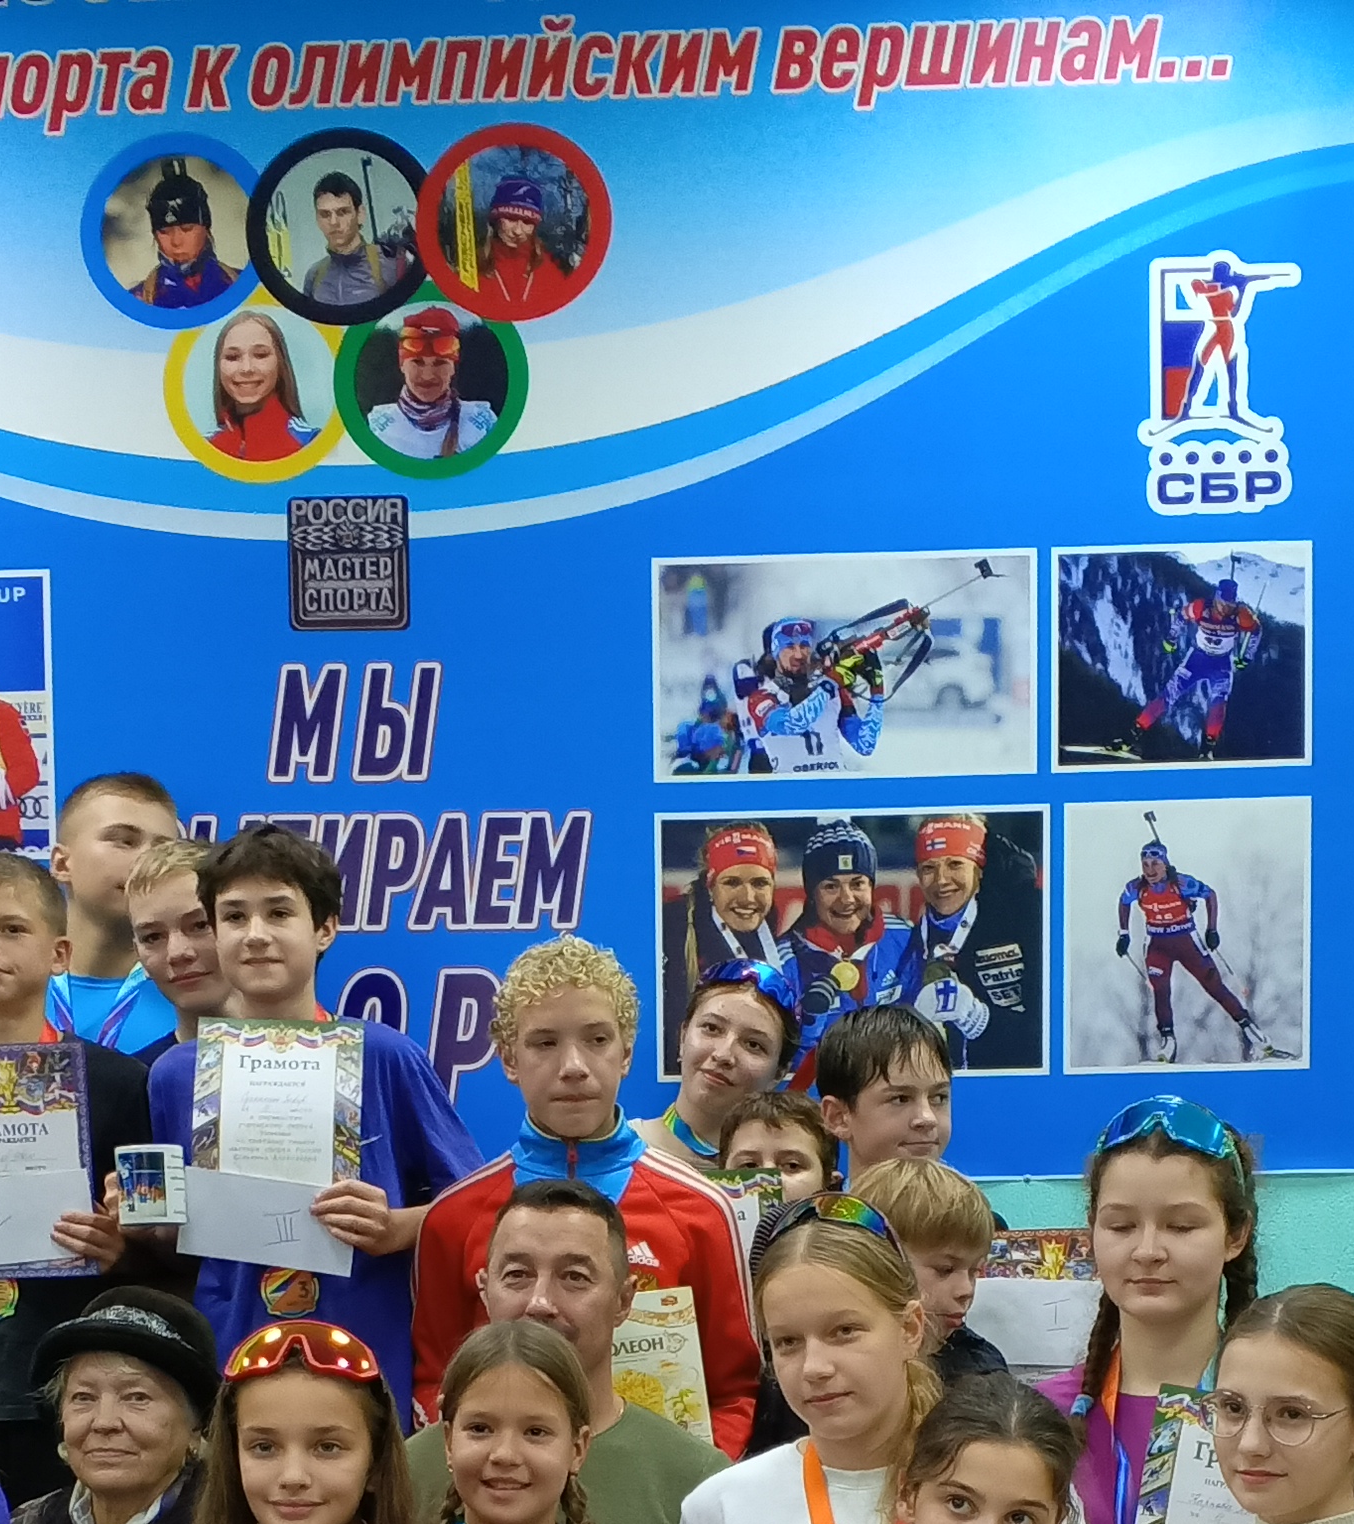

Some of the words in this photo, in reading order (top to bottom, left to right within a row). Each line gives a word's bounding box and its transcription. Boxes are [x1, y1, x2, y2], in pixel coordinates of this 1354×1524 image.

[190, 52, 230, 108] к
[250, 18, 755, 118] олимпийским
[772, 15, 1232, 108] вершинам...
[1155, 469, 1283, 506] СБР
[291, 498, 403, 525] РОССИЯ
[305, 557, 392, 580] МАСТЕР
[305, 588, 394, 612] СПОРТА
[267, 661, 442, 783] МЫ
[175, 810, 592, 933] ИРАЕМ
[238, 1055, 321, 1073] Грамота
[628, 1255, 661, 1269] didas
[298, 1281, 310, 1299] 3
